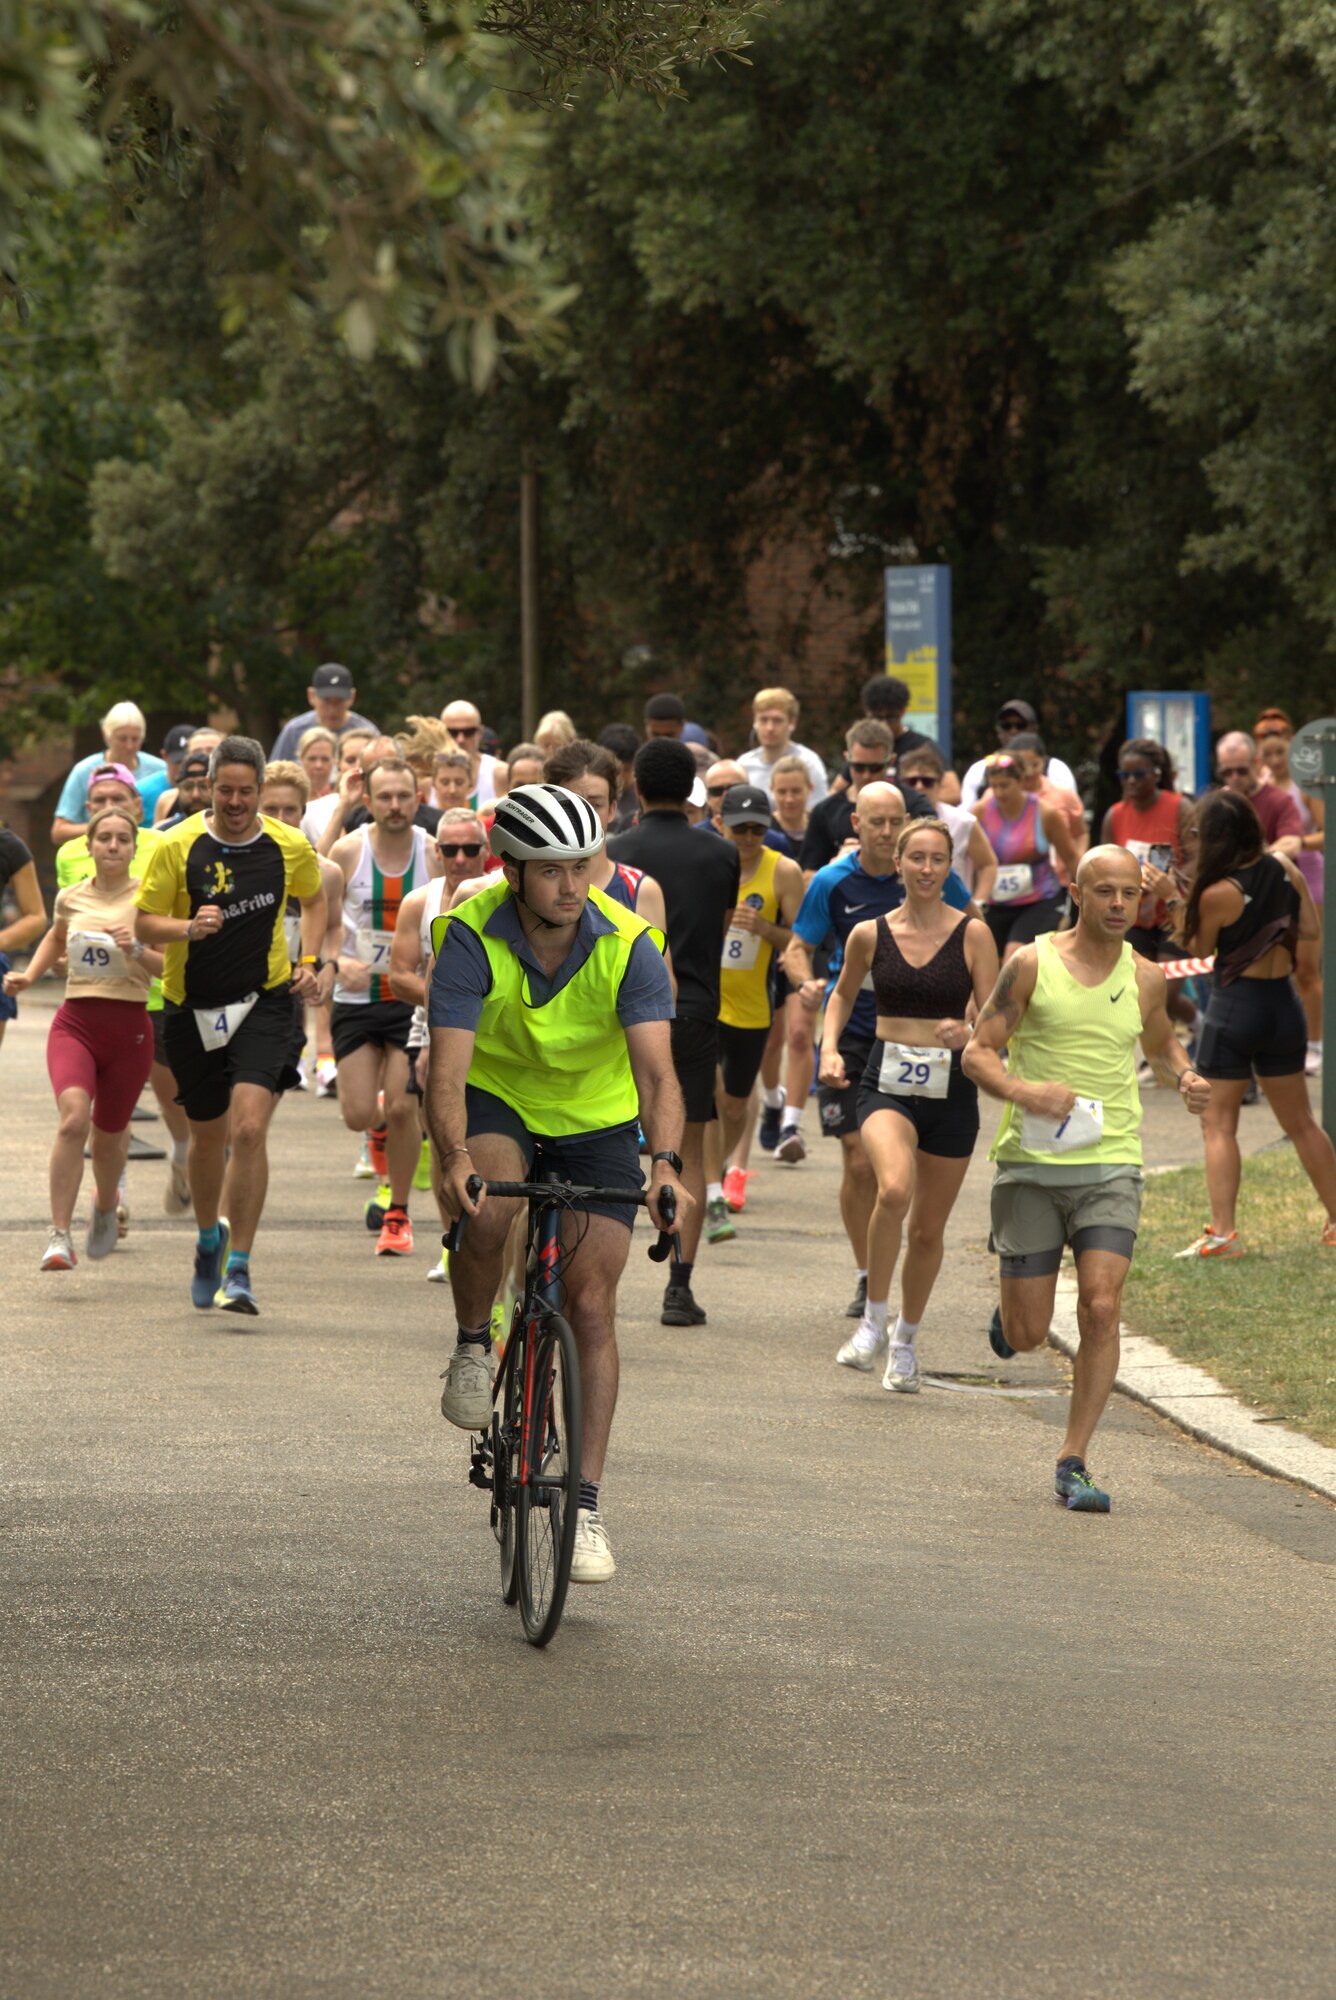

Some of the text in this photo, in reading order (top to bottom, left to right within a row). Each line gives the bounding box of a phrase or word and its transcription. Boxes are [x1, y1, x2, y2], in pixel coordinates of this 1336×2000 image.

[998, 876, 1020, 892] 45
[81, 946, 110, 967] 49
[214, 1012, 228, 1034] 4
[897, 1061, 931, 1085] 29
